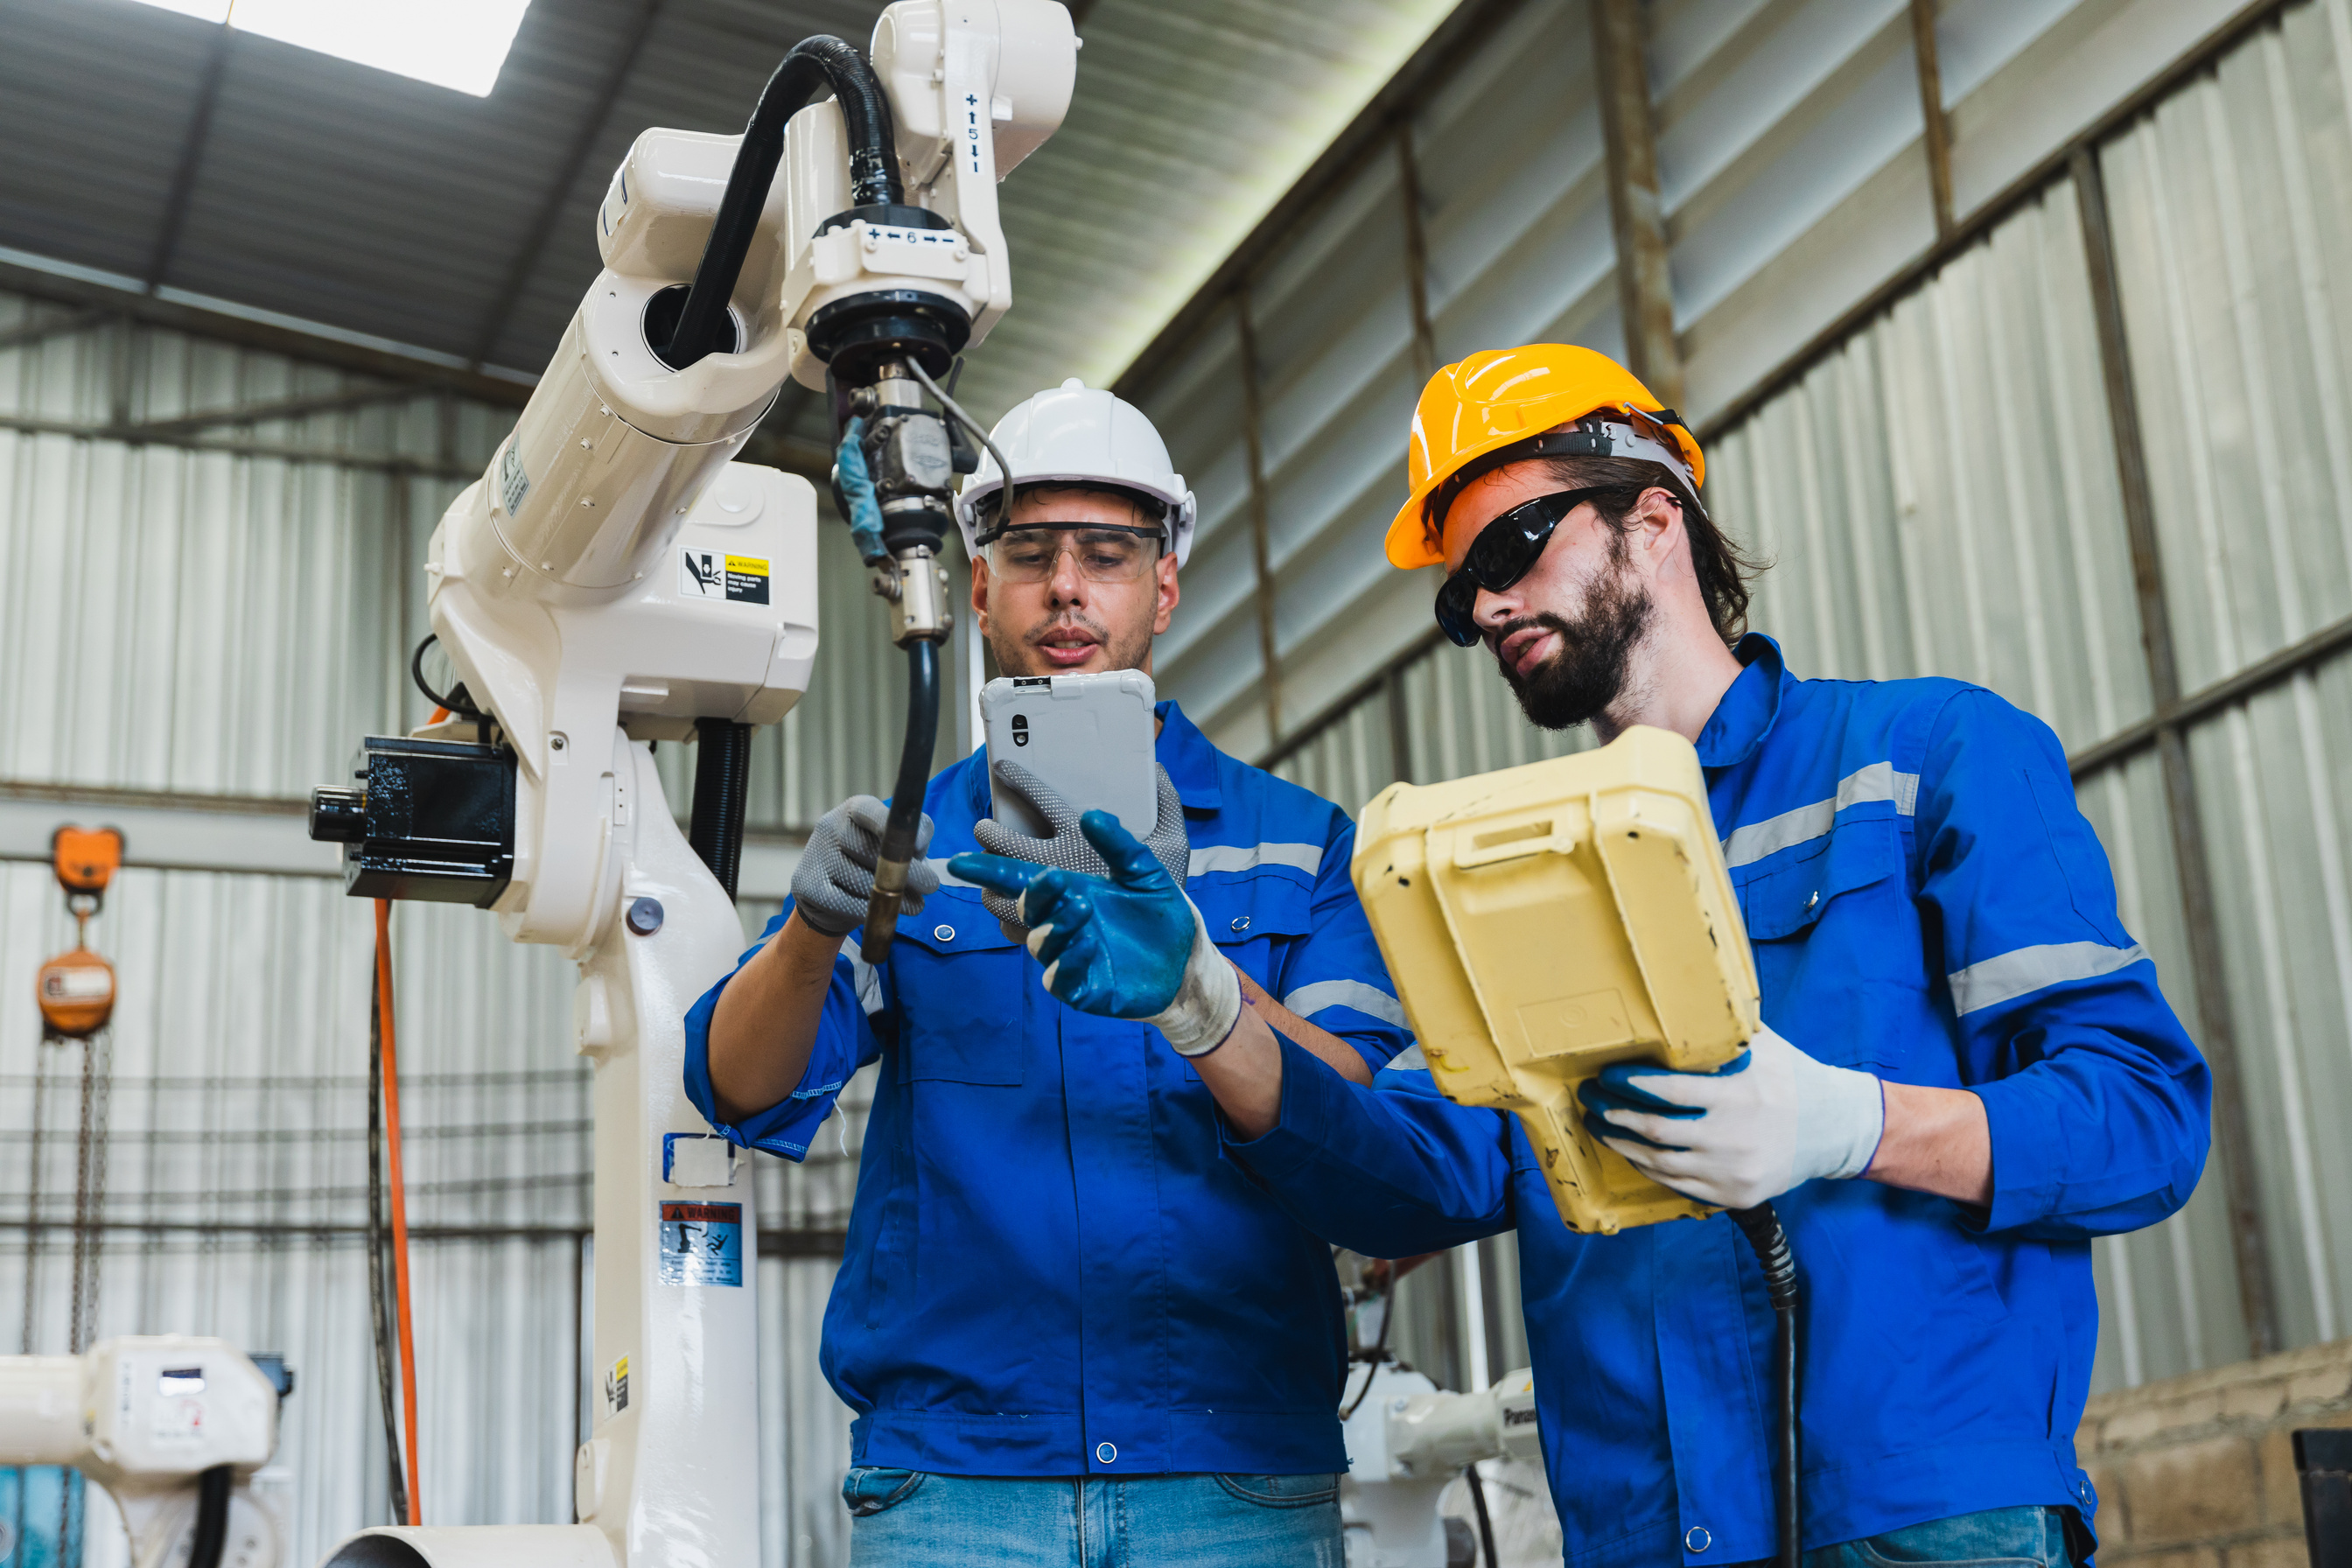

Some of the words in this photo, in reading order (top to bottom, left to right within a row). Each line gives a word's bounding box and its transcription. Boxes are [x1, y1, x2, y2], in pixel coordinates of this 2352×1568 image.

[969, 128, 978, 140] 5
[907, 232, 917, 243] 6
[737, 562, 767, 570] WARNING
[687, 1208, 735, 1221] WARNING
